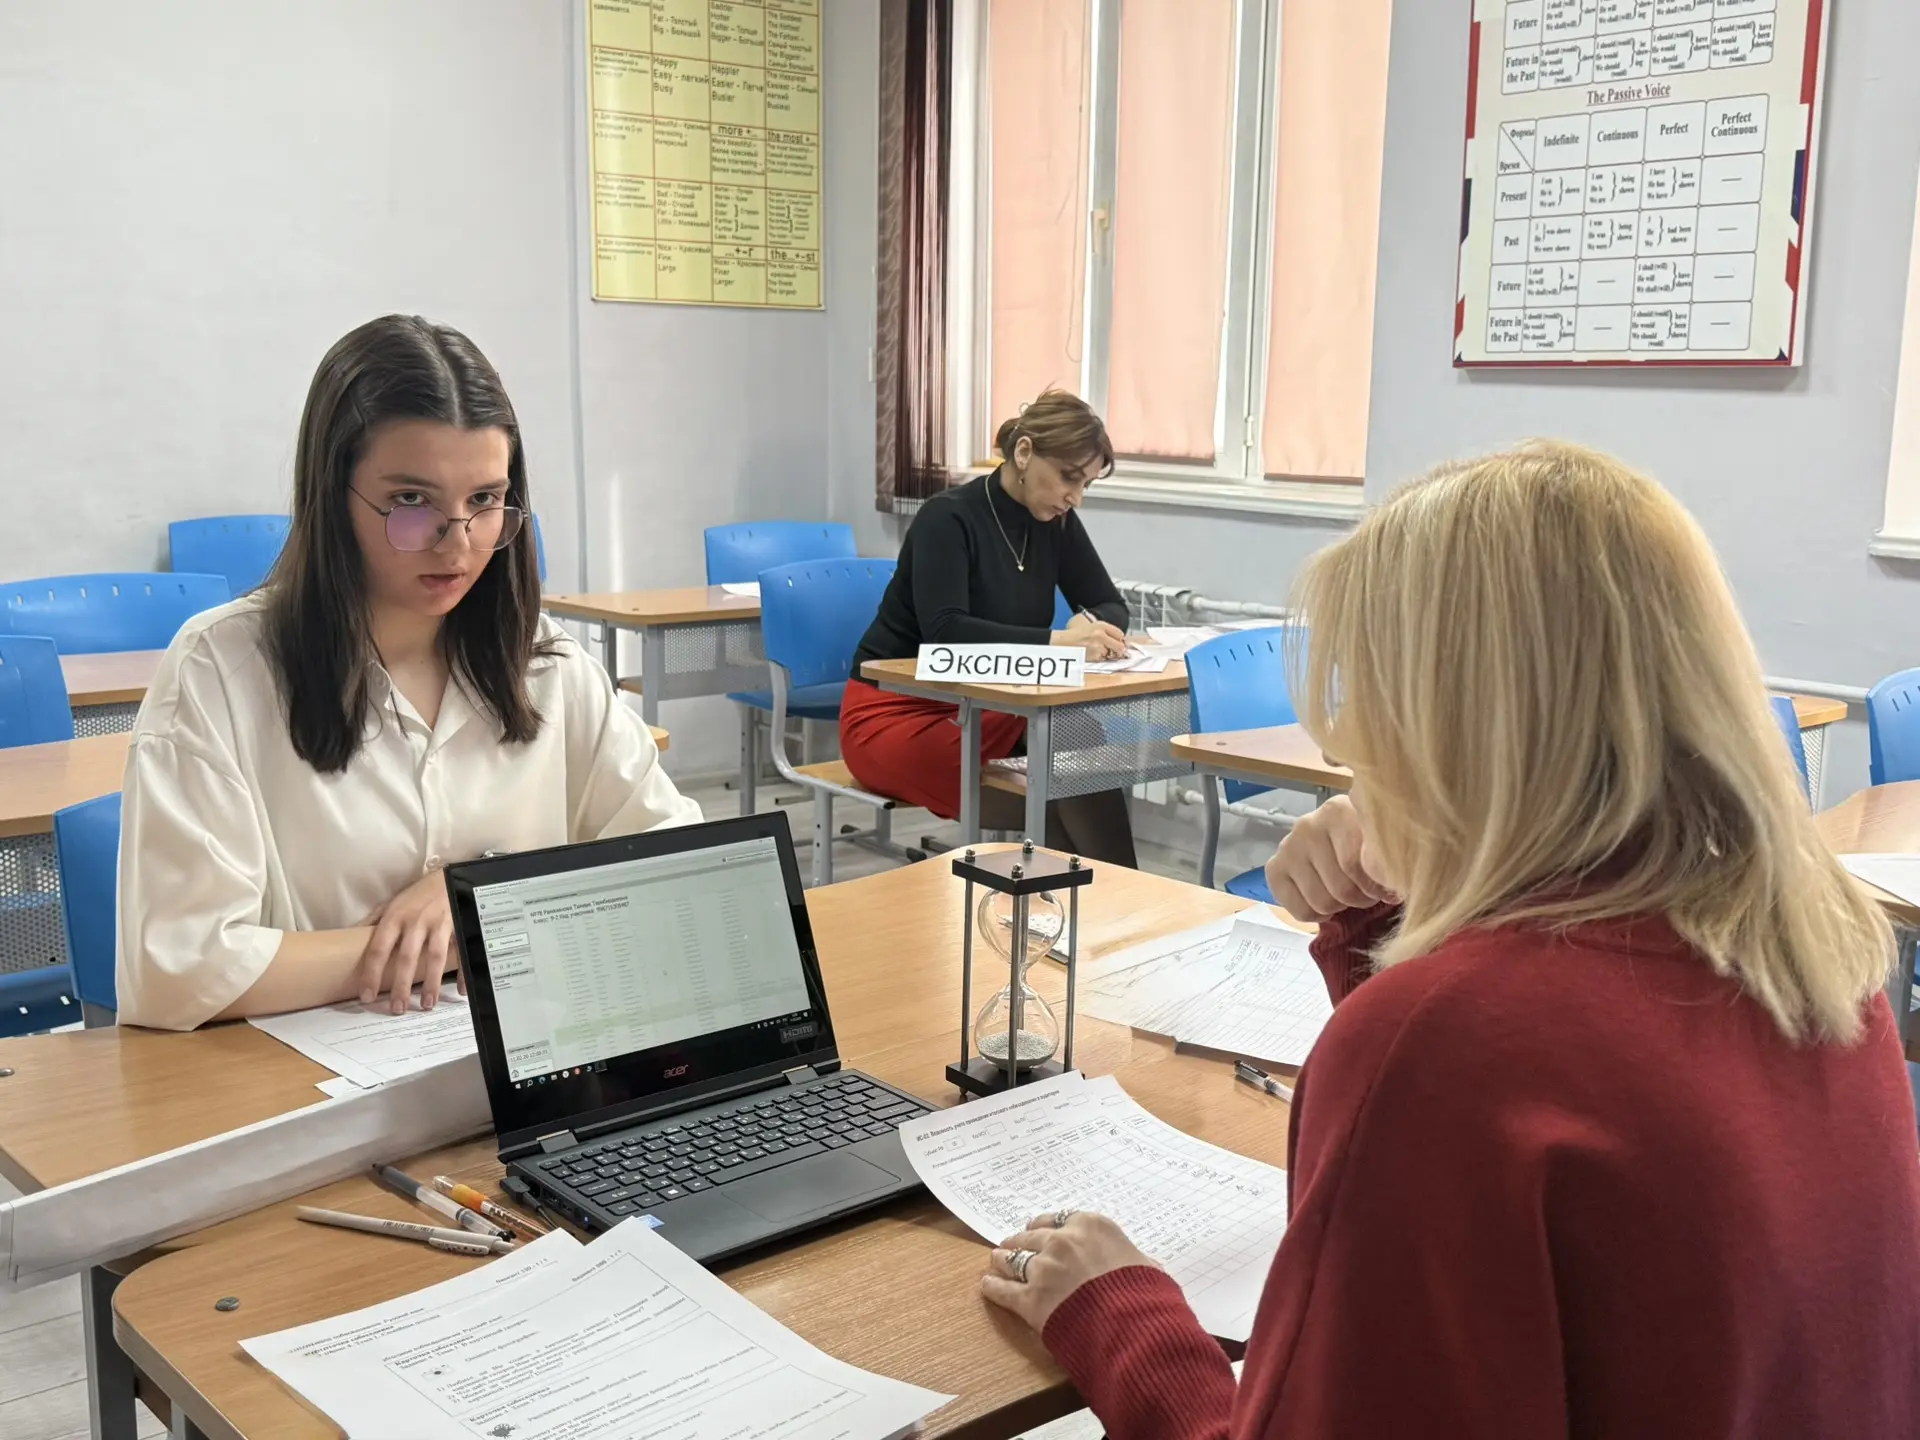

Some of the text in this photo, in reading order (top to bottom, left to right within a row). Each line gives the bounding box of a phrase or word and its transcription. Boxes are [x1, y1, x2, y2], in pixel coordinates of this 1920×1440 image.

[1513, 19, 1538, 30] Future
[653, 57, 678, 69] Happy
[1506, 53, 1539, 68] Future in
[653, 69, 672, 82] Easy
[1507, 70, 1536, 83] the Past
[653, 82, 673, 95] Busy
[1587, 83, 1671, 104] The Passive Voice
[1722, 112, 1752, 125] Perfect
[718, 125, 743, 136] more
[1660, 122, 1688, 135] Perfect
[1711, 125, 1758, 137] Continuous
[1544, 134, 1580, 147] Indefinite
[1597, 130, 1639, 142] Continuous
[1501, 191, 1527, 202] Present
[1504, 236, 1519, 246] Past
[1497, 281, 1521, 291] Future
[1490, 316, 1522, 328] Future in
[1491, 331, 1519, 343] the Past
[929, 647, 1076, 684] Эксперт
[663, 1064, 688, 1078] acer
